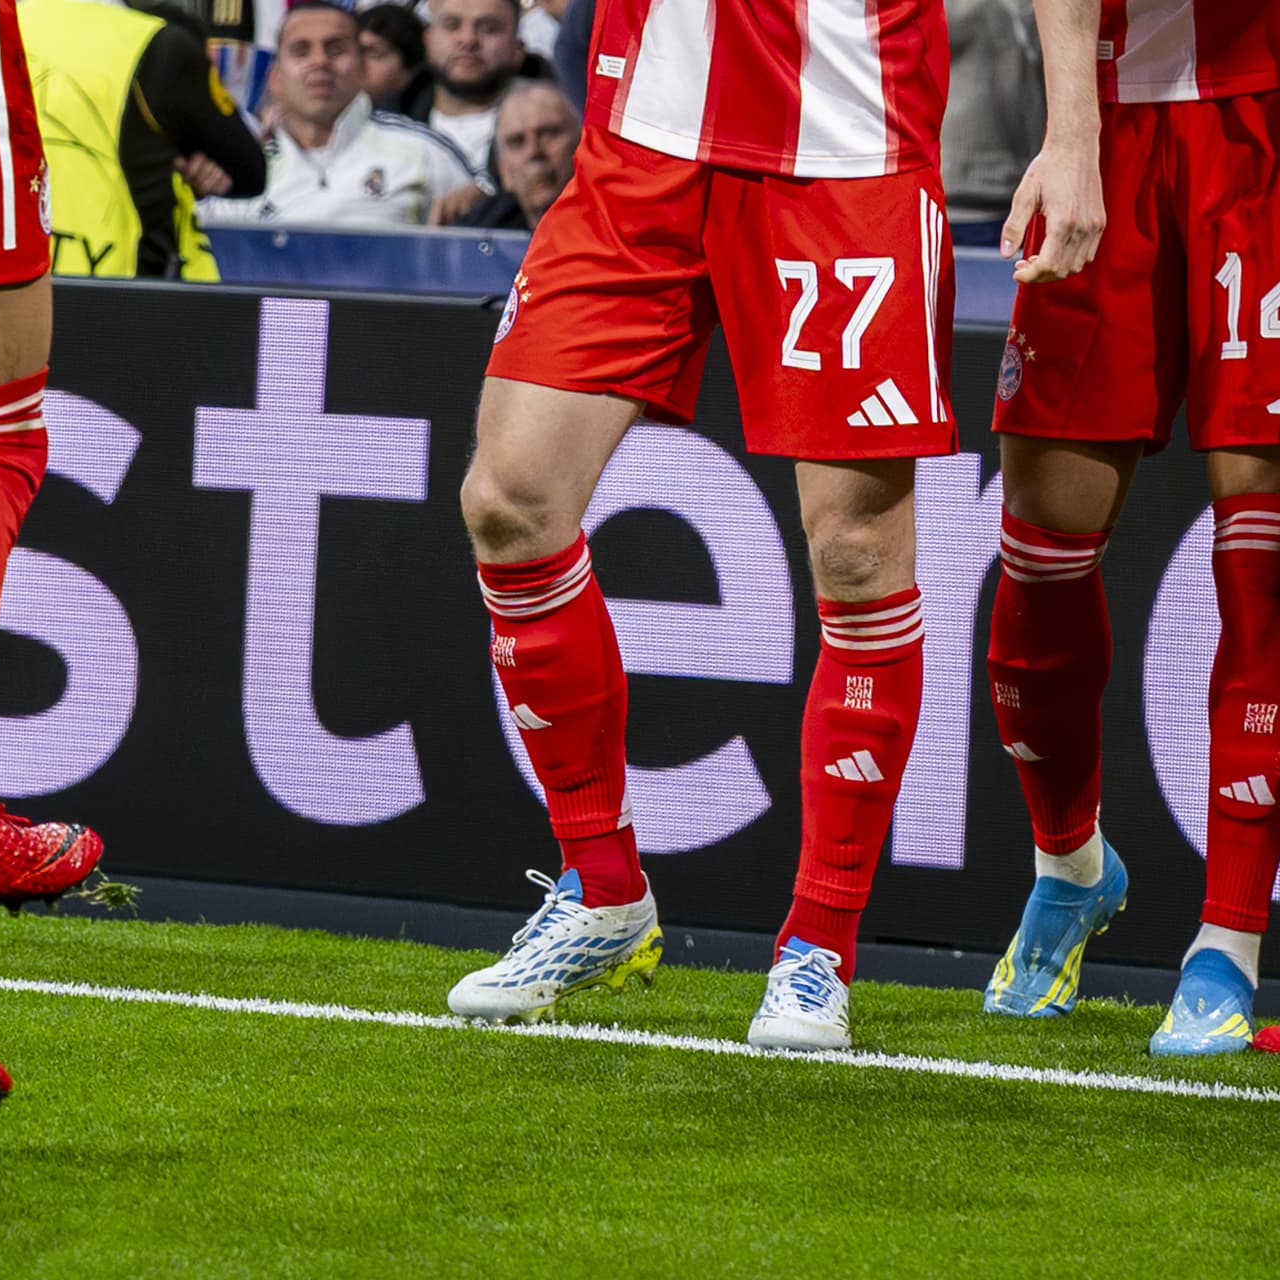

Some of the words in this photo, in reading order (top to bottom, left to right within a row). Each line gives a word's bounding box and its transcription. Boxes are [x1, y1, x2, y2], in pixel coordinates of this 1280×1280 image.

[775, 257, 896, 371] 27
[846, 675, 873, 688] MIA
[845, 686, 872, 700] SAN
[843, 697, 872, 710] MIA
[1244, 722, 1273, 734] MIA
